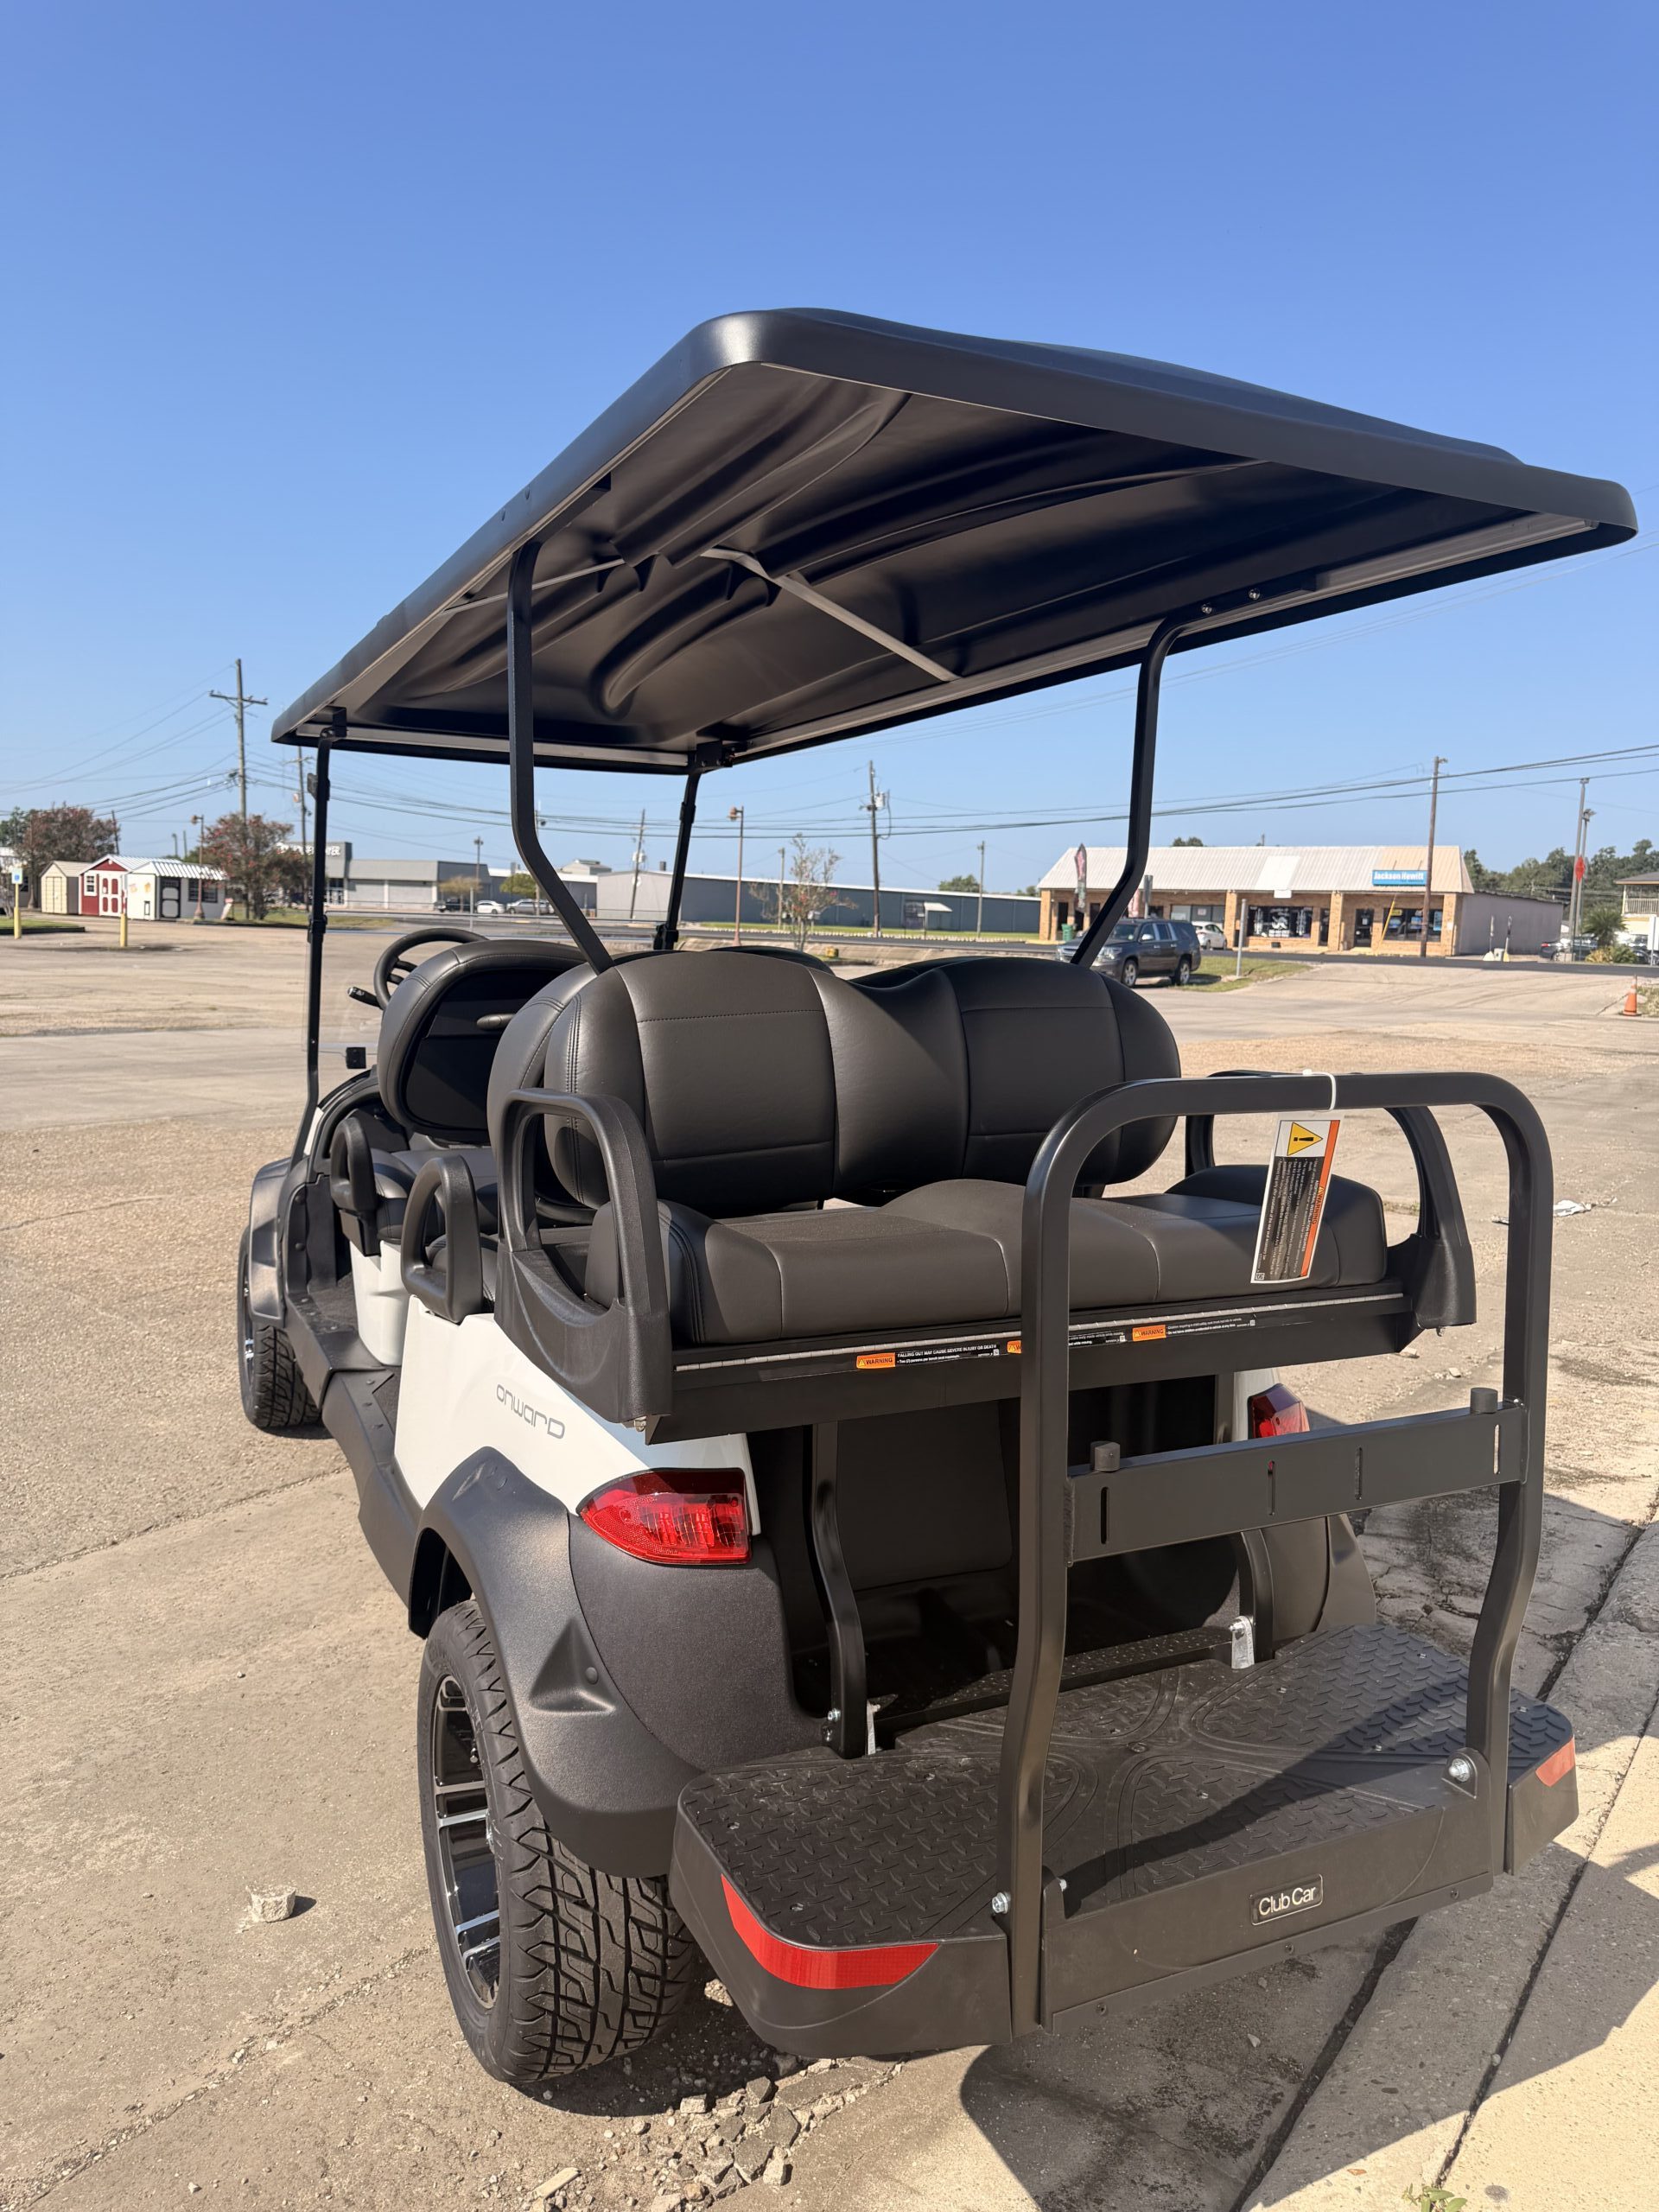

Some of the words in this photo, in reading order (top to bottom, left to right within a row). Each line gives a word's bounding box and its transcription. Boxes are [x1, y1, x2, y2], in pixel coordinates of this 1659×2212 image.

[1312, 1192, 1323, 1224] WARNING
[1258, 1892, 1290, 1916] Club
[1292, 1886, 1316, 1905] Car
